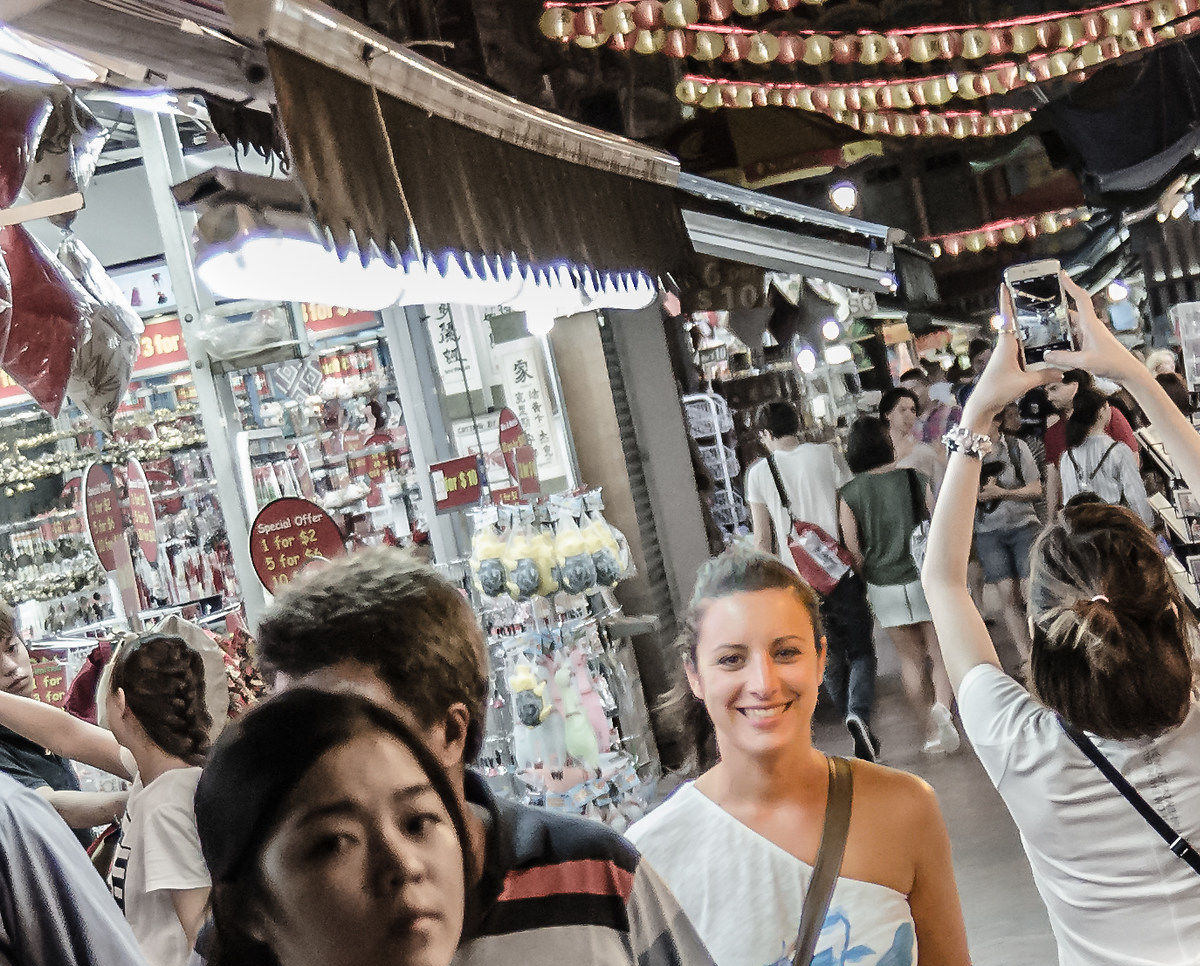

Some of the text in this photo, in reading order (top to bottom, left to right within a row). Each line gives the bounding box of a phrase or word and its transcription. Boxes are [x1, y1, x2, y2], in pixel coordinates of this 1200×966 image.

[154, 333, 180, 355] for
[256, 512, 323, 535] Special Offer
[261, 528, 318, 552] 1 for $2
[265, 556, 276, 571] 5
[280, 553, 300, 568] for
[43, 675, 63, 688] for
[45, 690, 65, 703] for
